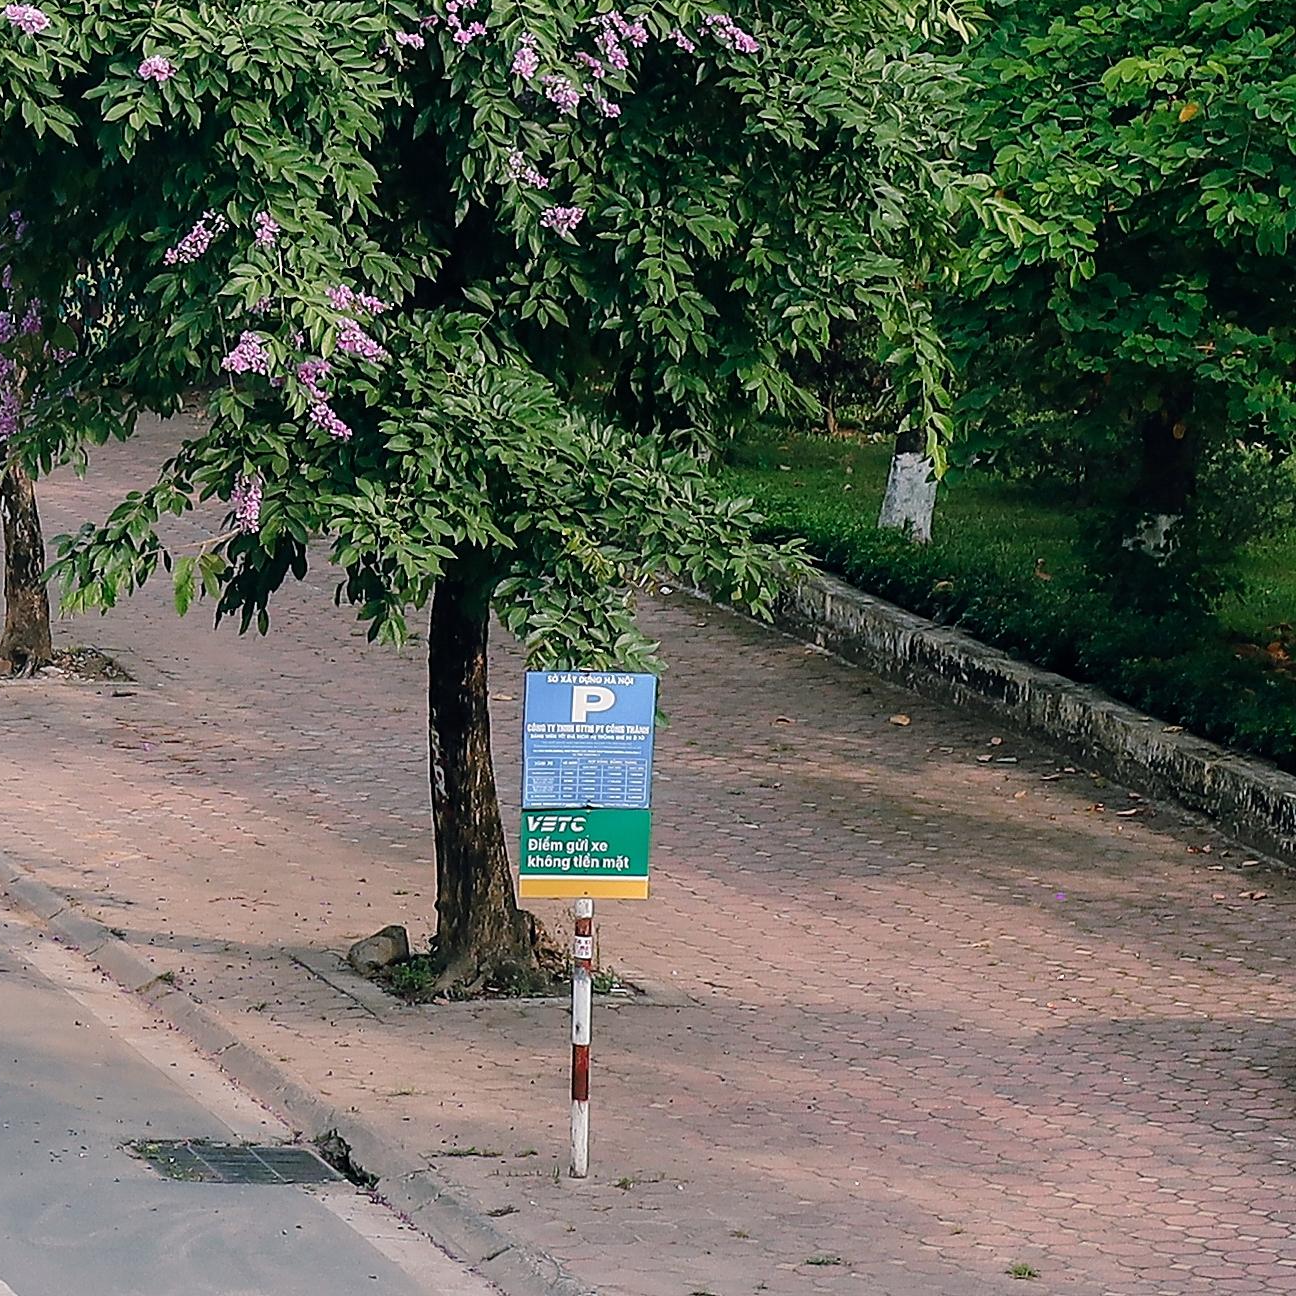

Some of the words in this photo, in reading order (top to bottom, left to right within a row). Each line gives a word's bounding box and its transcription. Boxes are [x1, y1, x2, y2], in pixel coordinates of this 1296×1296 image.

[571, 685, 616, 723] P
[527, 816, 586, 832] VETC
[528, 836, 563, 852] Điểm
[566, 837, 589, 854] gửi
[590, 841, 608, 852] xe
[527, 854, 571, 871] không
[573, 853, 600, 869] tiền
[602, 855, 630, 871] mặt
